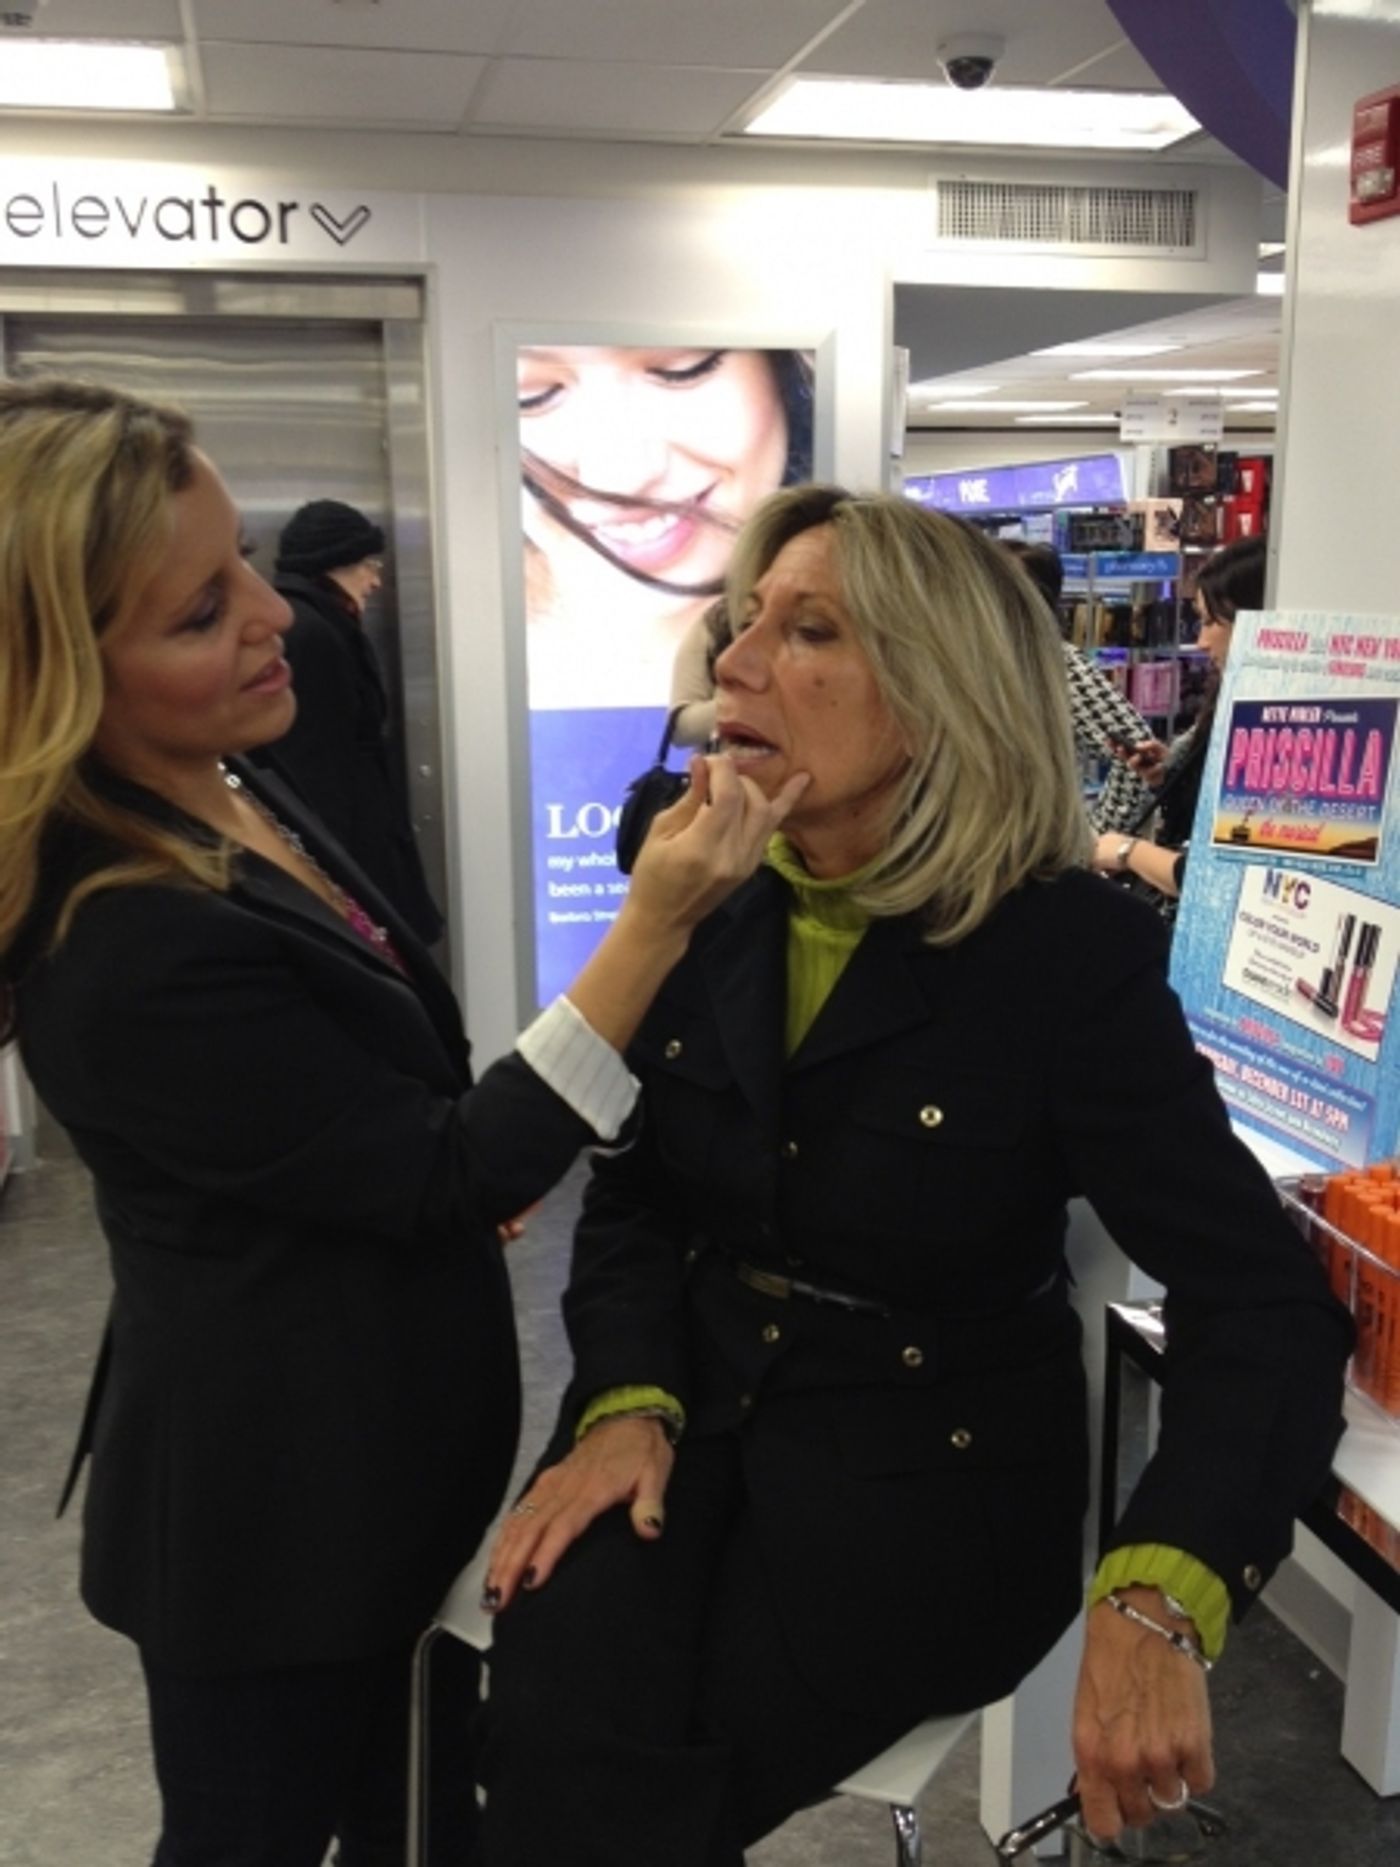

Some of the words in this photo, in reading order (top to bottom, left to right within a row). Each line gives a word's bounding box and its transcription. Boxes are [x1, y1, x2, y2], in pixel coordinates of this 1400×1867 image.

[5, 181, 299, 245] elevator
[1226, 727, 1383, 796] PRISCILLA
[1319, 802, 1377, 821] DESERT
[547, 855, 574, 871] my
[548, 881, 592, 897] been
[594, 883, 605, 896] a
